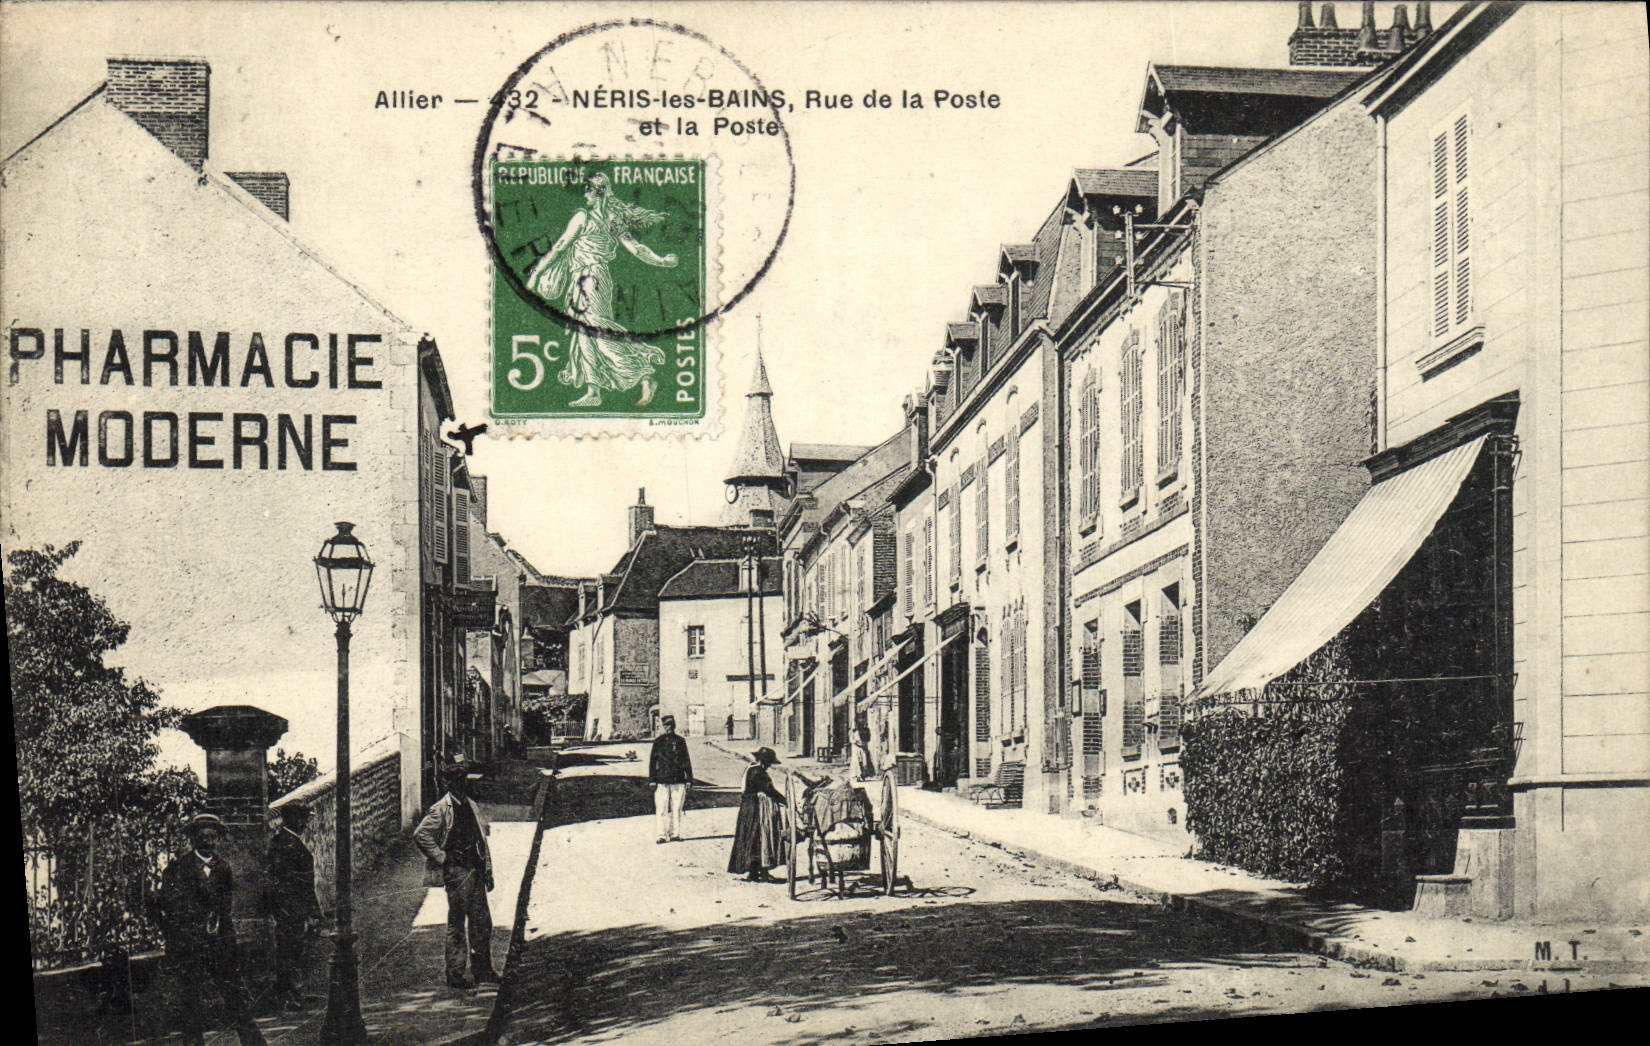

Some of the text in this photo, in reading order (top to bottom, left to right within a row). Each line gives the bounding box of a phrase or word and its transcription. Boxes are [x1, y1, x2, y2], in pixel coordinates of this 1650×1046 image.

[613, 165, 696, 187] FRANÇAISE
[9, 327, 383, 390] PHARMACIE
[675, 315, 696, 403] POSTES
[46, 408, 358, 472] MODERNE
